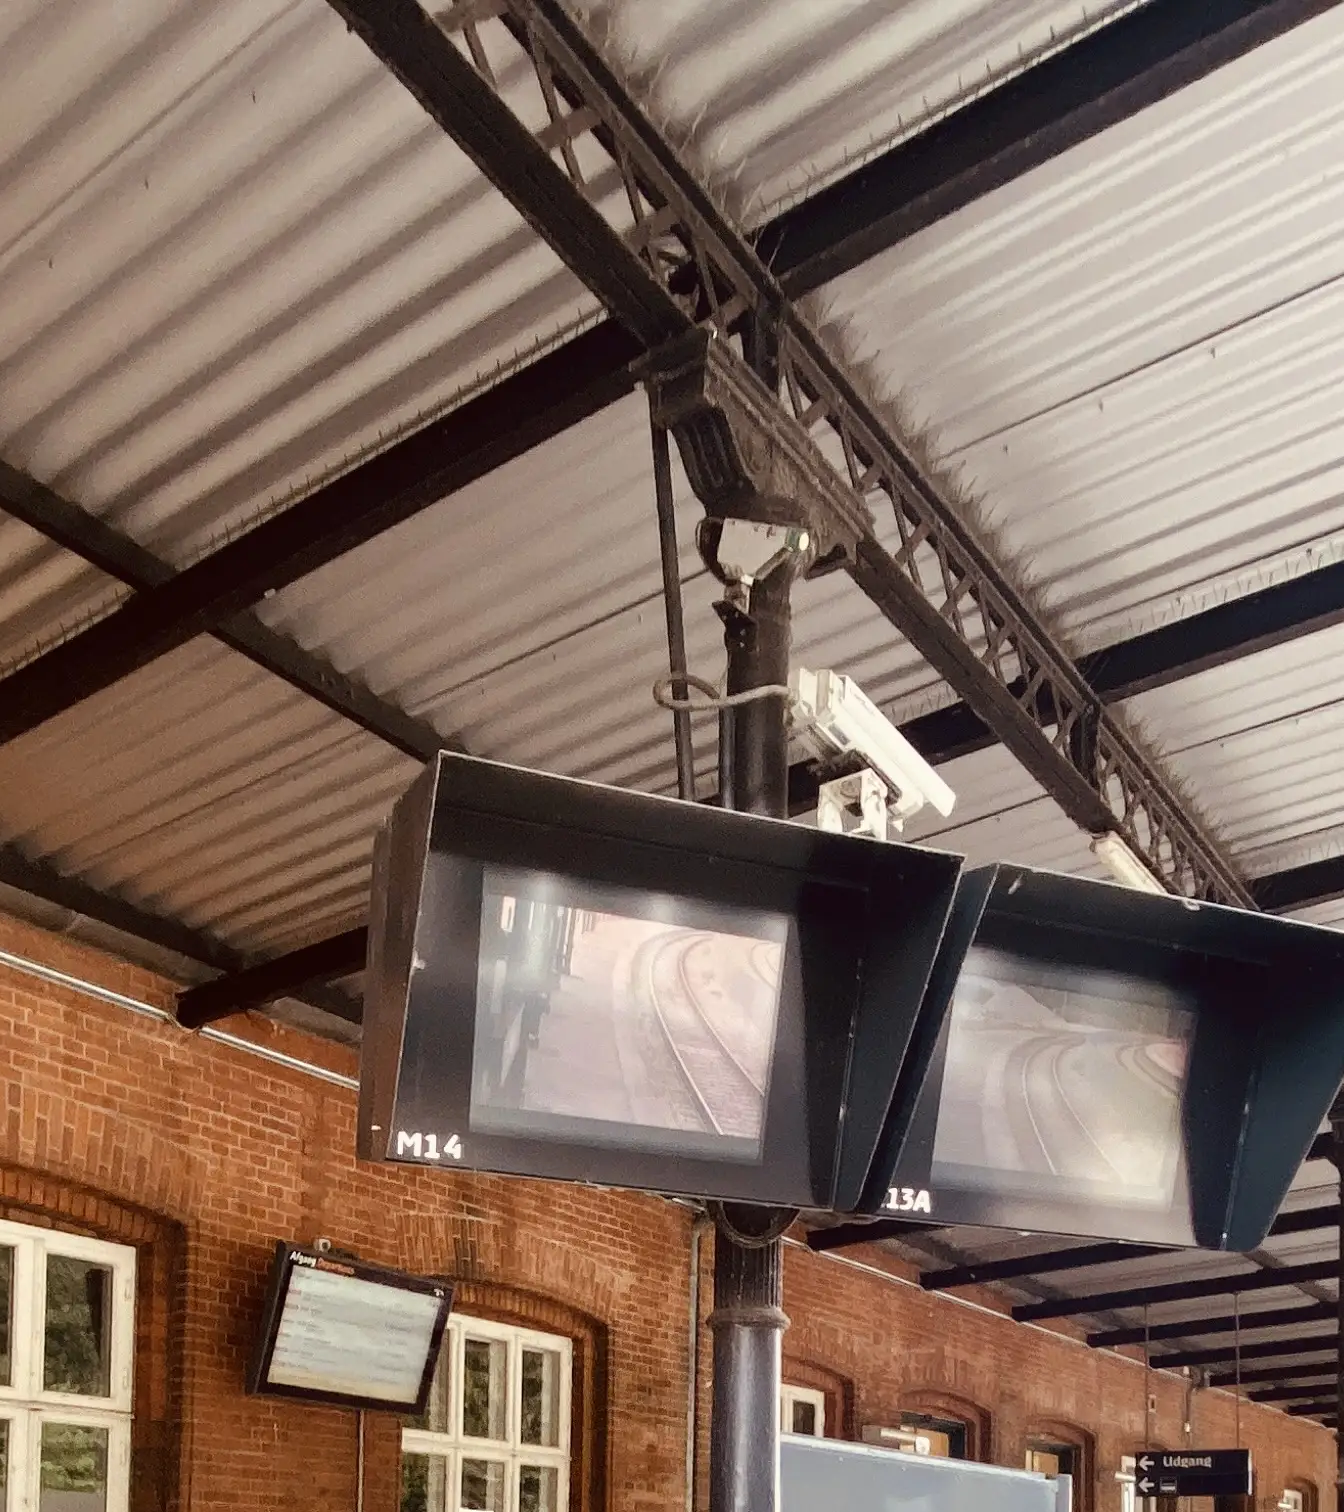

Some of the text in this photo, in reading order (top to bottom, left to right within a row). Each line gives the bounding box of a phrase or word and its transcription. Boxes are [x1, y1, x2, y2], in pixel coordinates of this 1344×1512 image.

[397, 1131, 462, 1159] M14
[881, 1187, 931, 1213] 13A
[1162, 1456, 1212, 1468] Udgang
